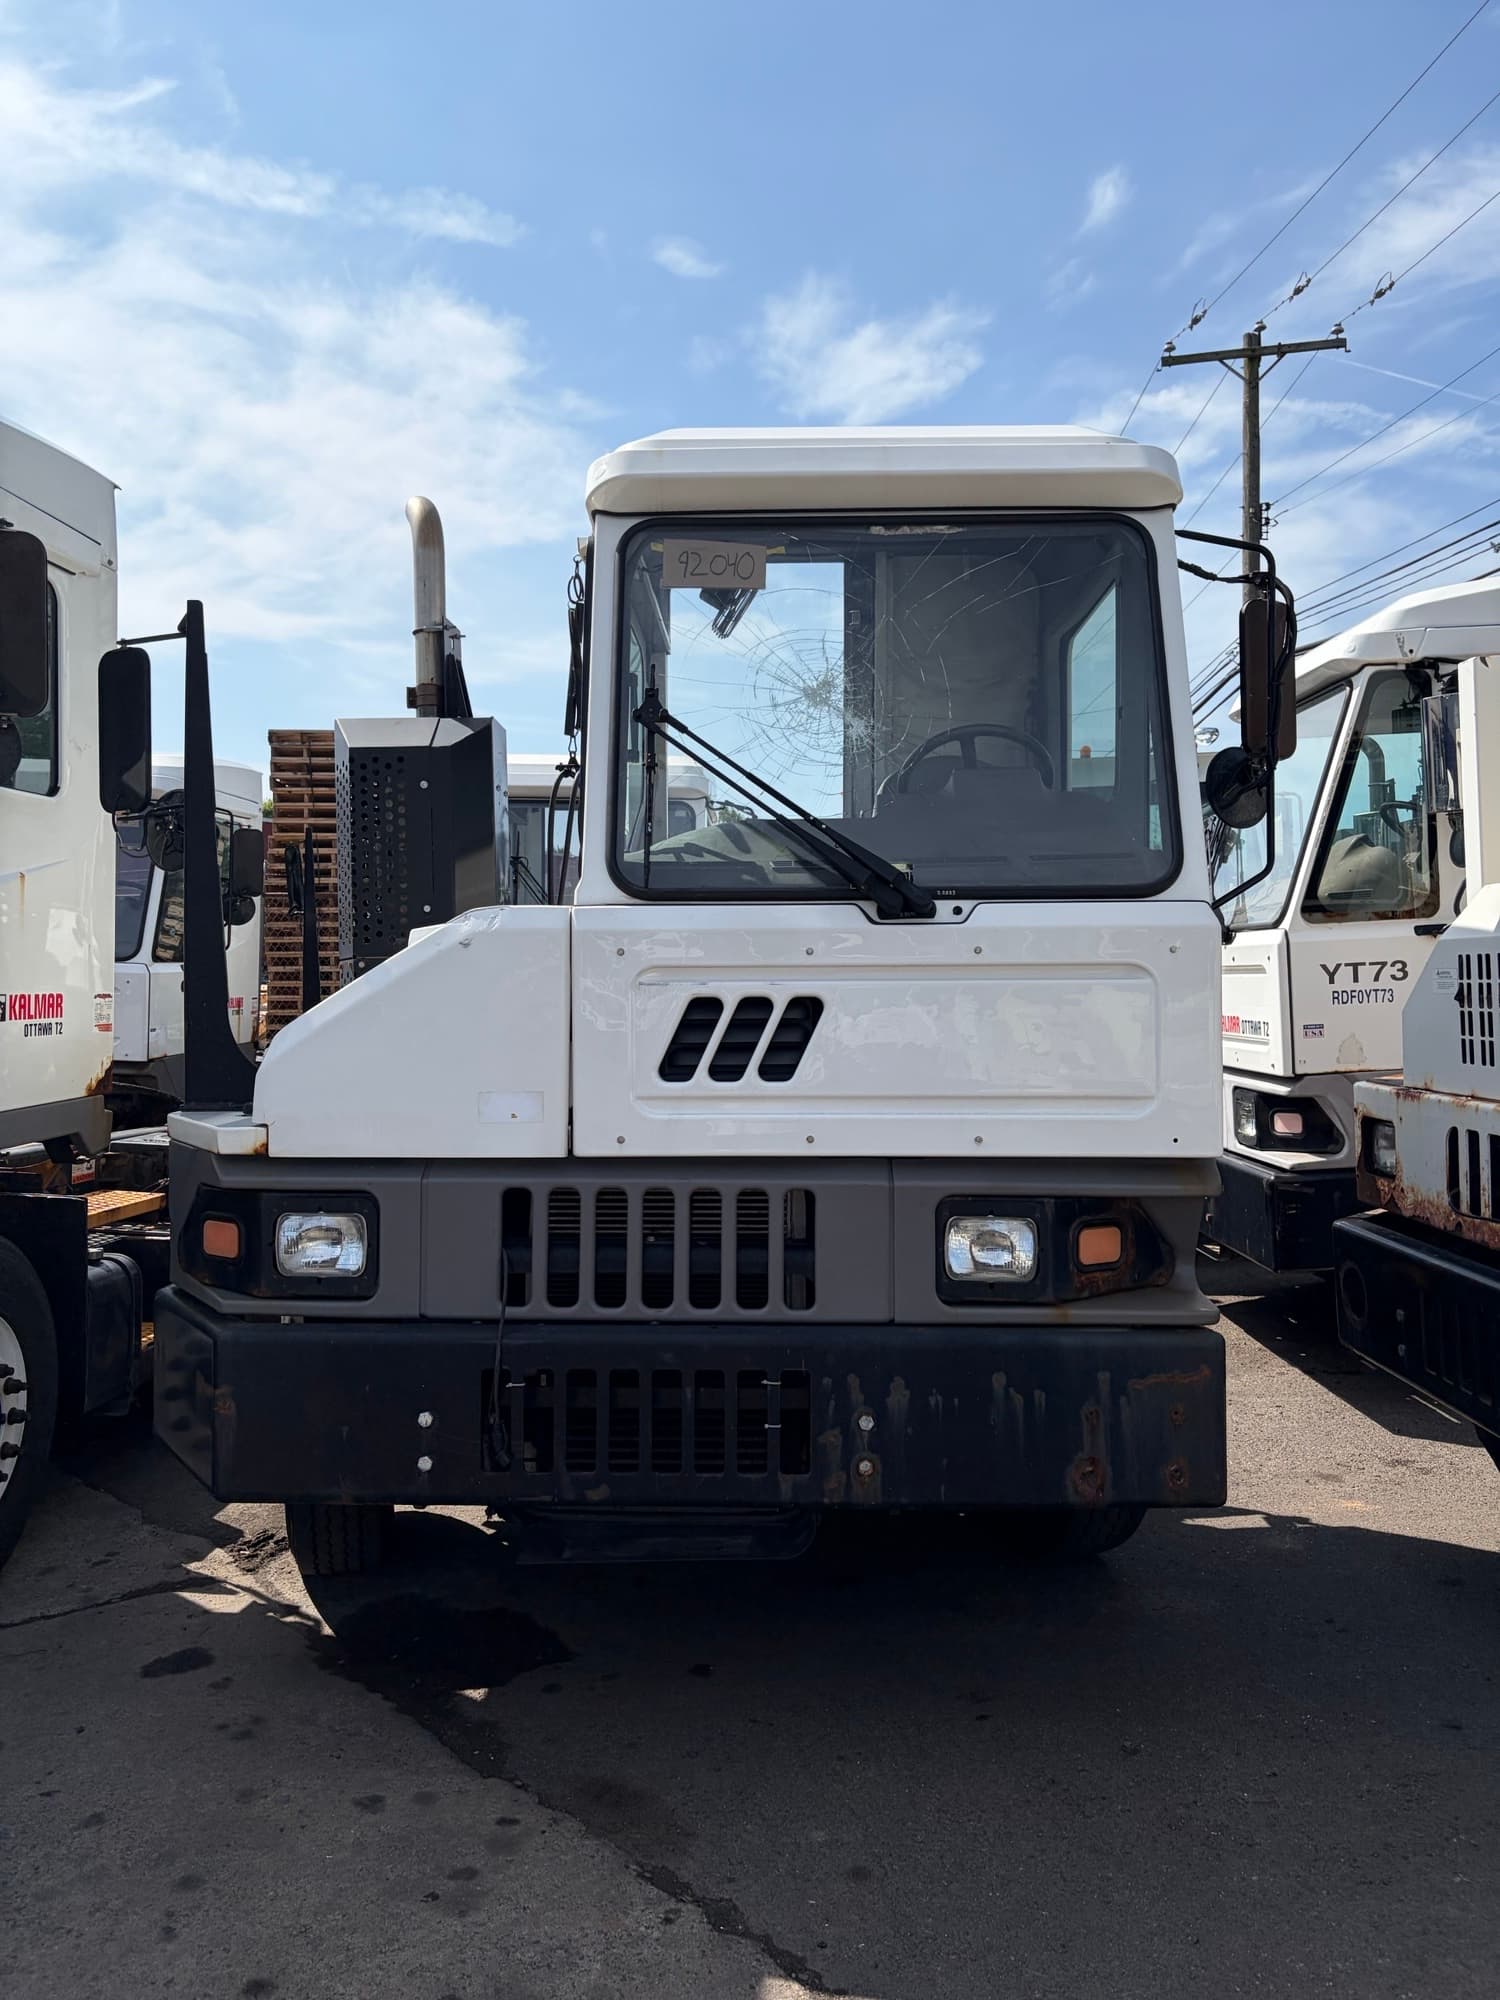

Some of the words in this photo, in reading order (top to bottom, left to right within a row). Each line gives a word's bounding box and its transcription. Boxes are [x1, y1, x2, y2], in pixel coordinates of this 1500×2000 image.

[677, 550, 755, 580] 92040
[1320, 960, 1408, 984] YT73
[9, 993, 63, 1020] KALMAR
[24, 1023, 53, 1037] OTTAWA
[55, 1022, 63, 1035] T2
[1221, 1015, 1240, 1034] ALMAR
[1241, 1019, 1262, 1036] OTTAWA
[1262, 1021, 1270, 1037] T2
